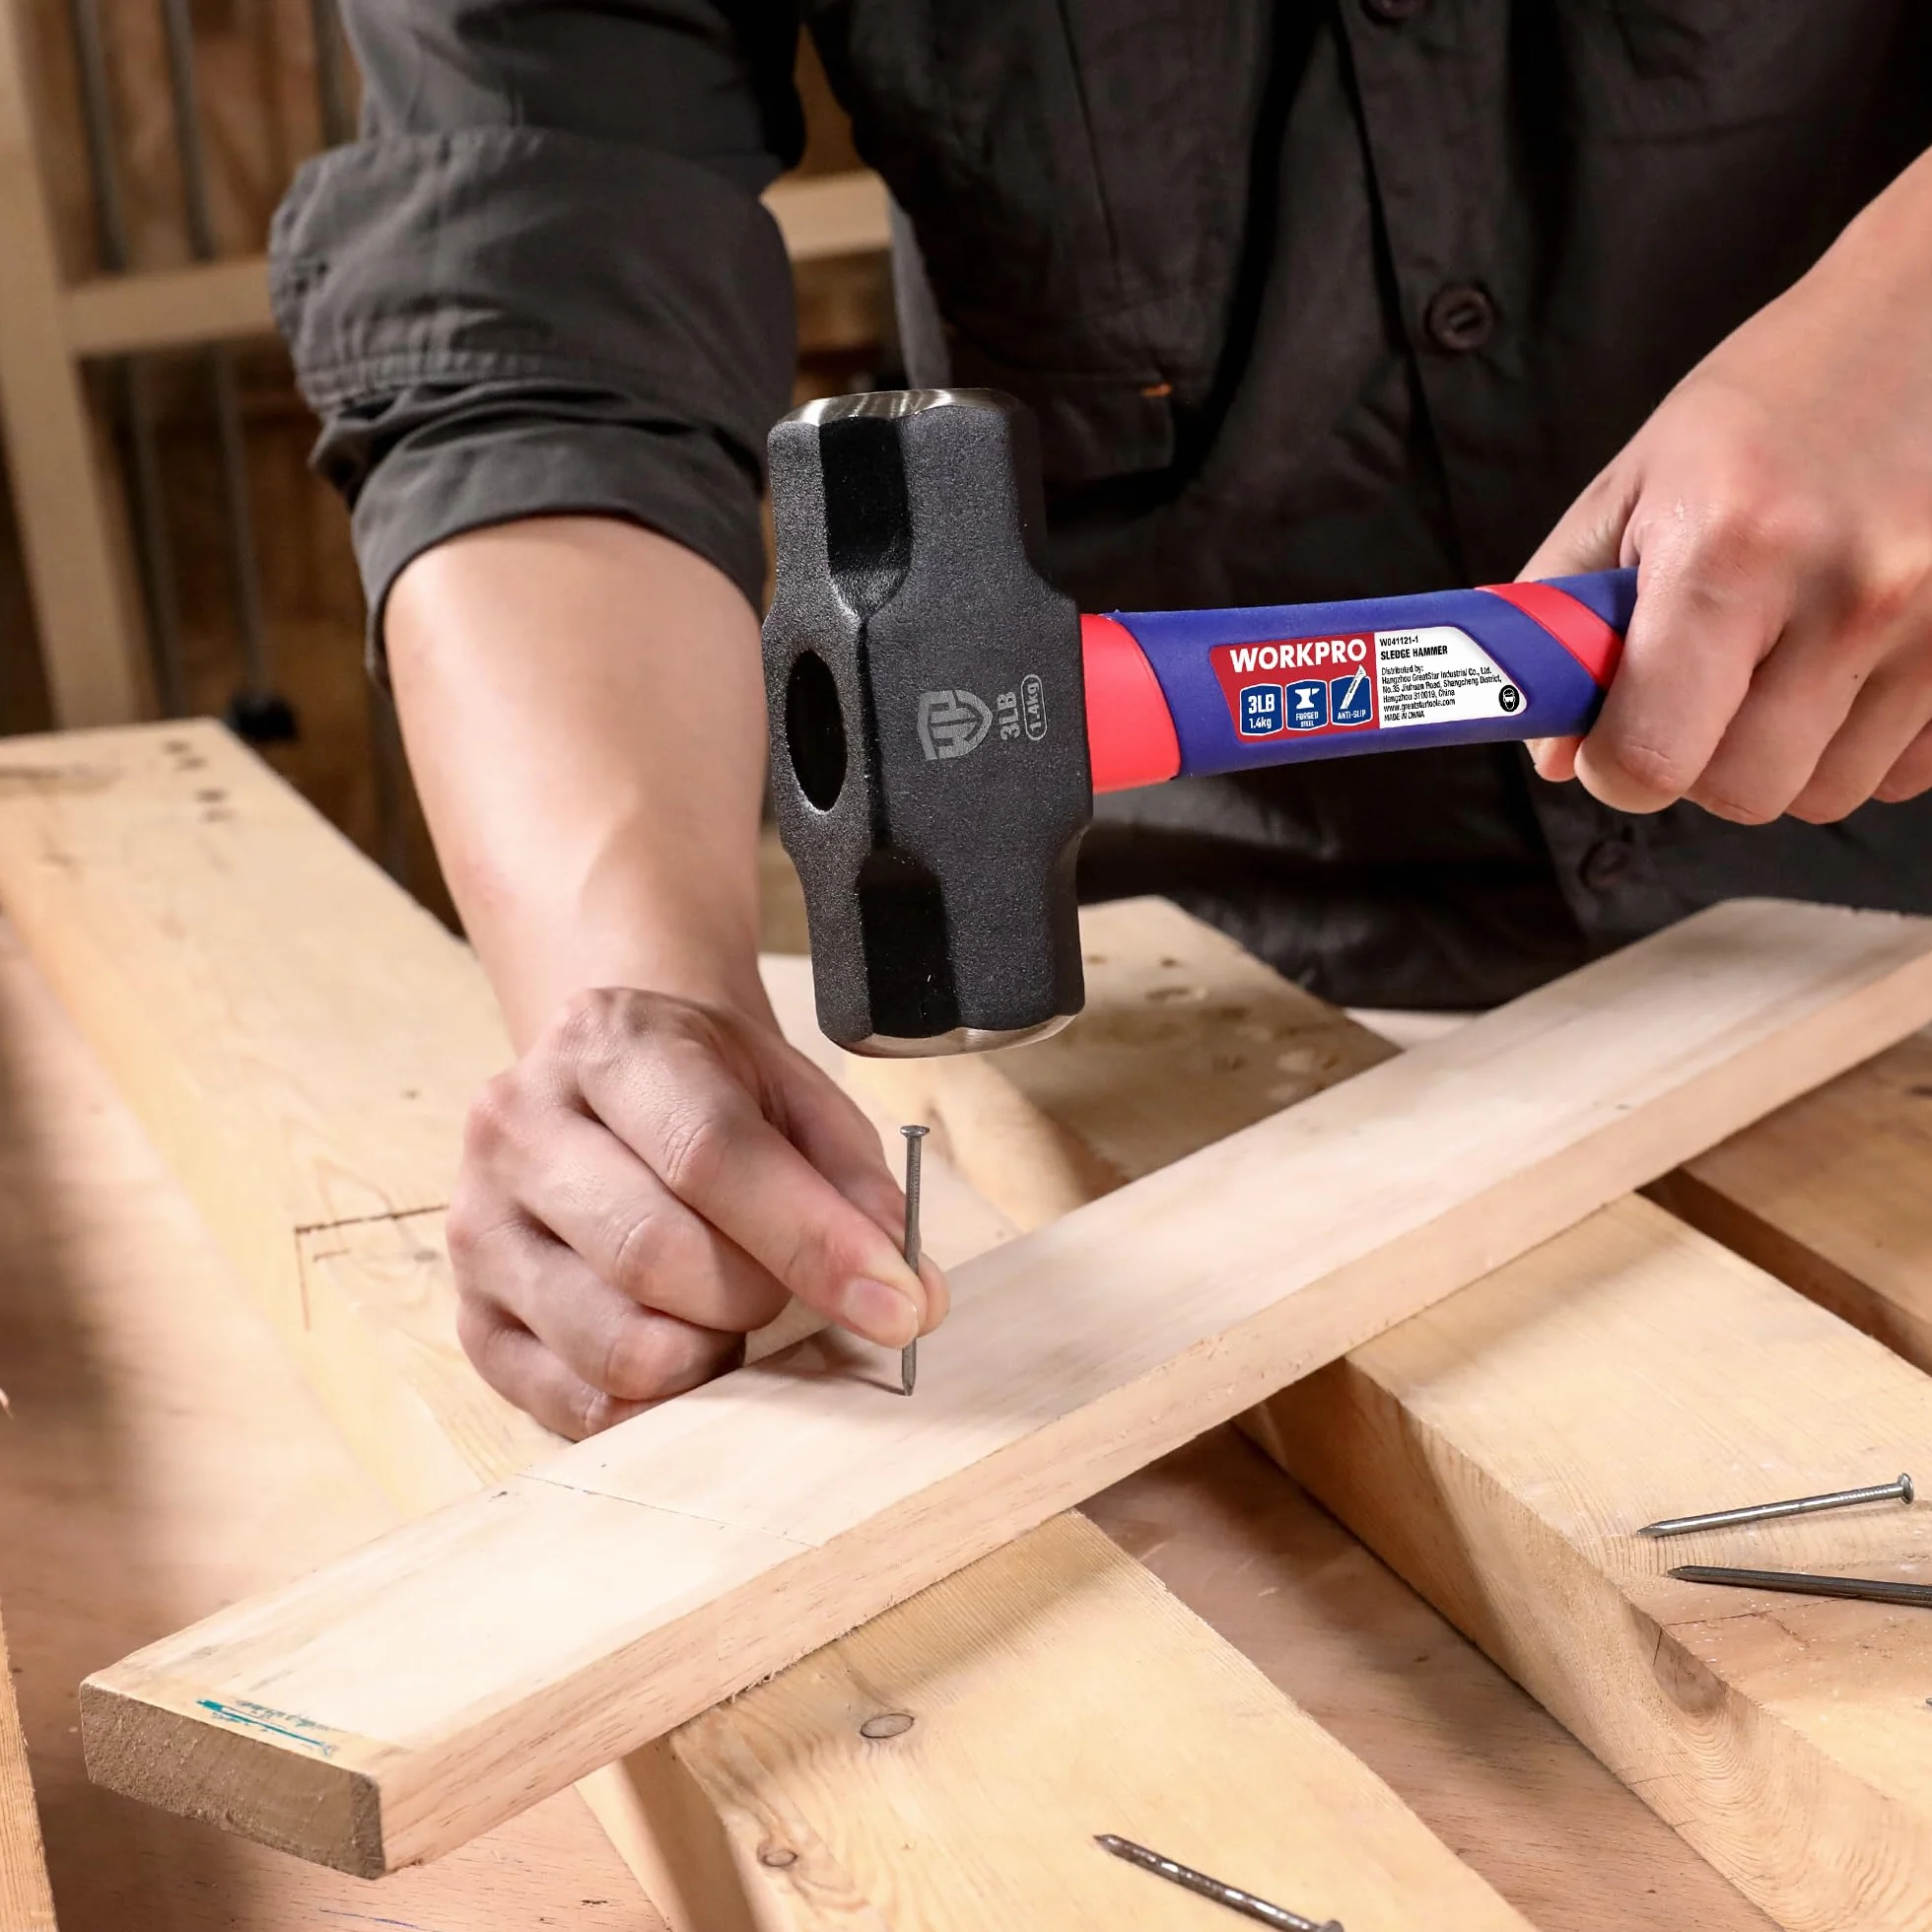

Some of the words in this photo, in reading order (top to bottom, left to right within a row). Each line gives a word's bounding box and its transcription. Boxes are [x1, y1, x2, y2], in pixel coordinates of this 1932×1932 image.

[1379, 635, 1418, 647] W041121-1
[1229, 639, 1367, 673] WORKPRO
[1380, 649, 1411, 660] SLEDGE
[1413, 645, 1448, 657] HAMMER
[1381, 664, 1414, 675] Distributed
[1381, 675, 1412, 685] Hangzhou
[1413, 672, 1440, 681] GreatStar
[1440, 669, 1468, 678] Industrial
[1443, 678, 1479, 688] Shangcheng
[1383, 694, 1413, 704] Hangzhou
[1438, 689, 1455, 698] China
[1025, 682, 1043, 731] 1.4kg
[1248, 693, 1276, 715] 3LB
[996, 691, 1021, 740] 3LB
[1295, 711, 1319, 721] FORGED
[1337, 709, 1366, 721] ANTI-SLIP
[1384, 713, 1401, 722] MADE
[1249, 718, 1272, 729] 1.4kg
